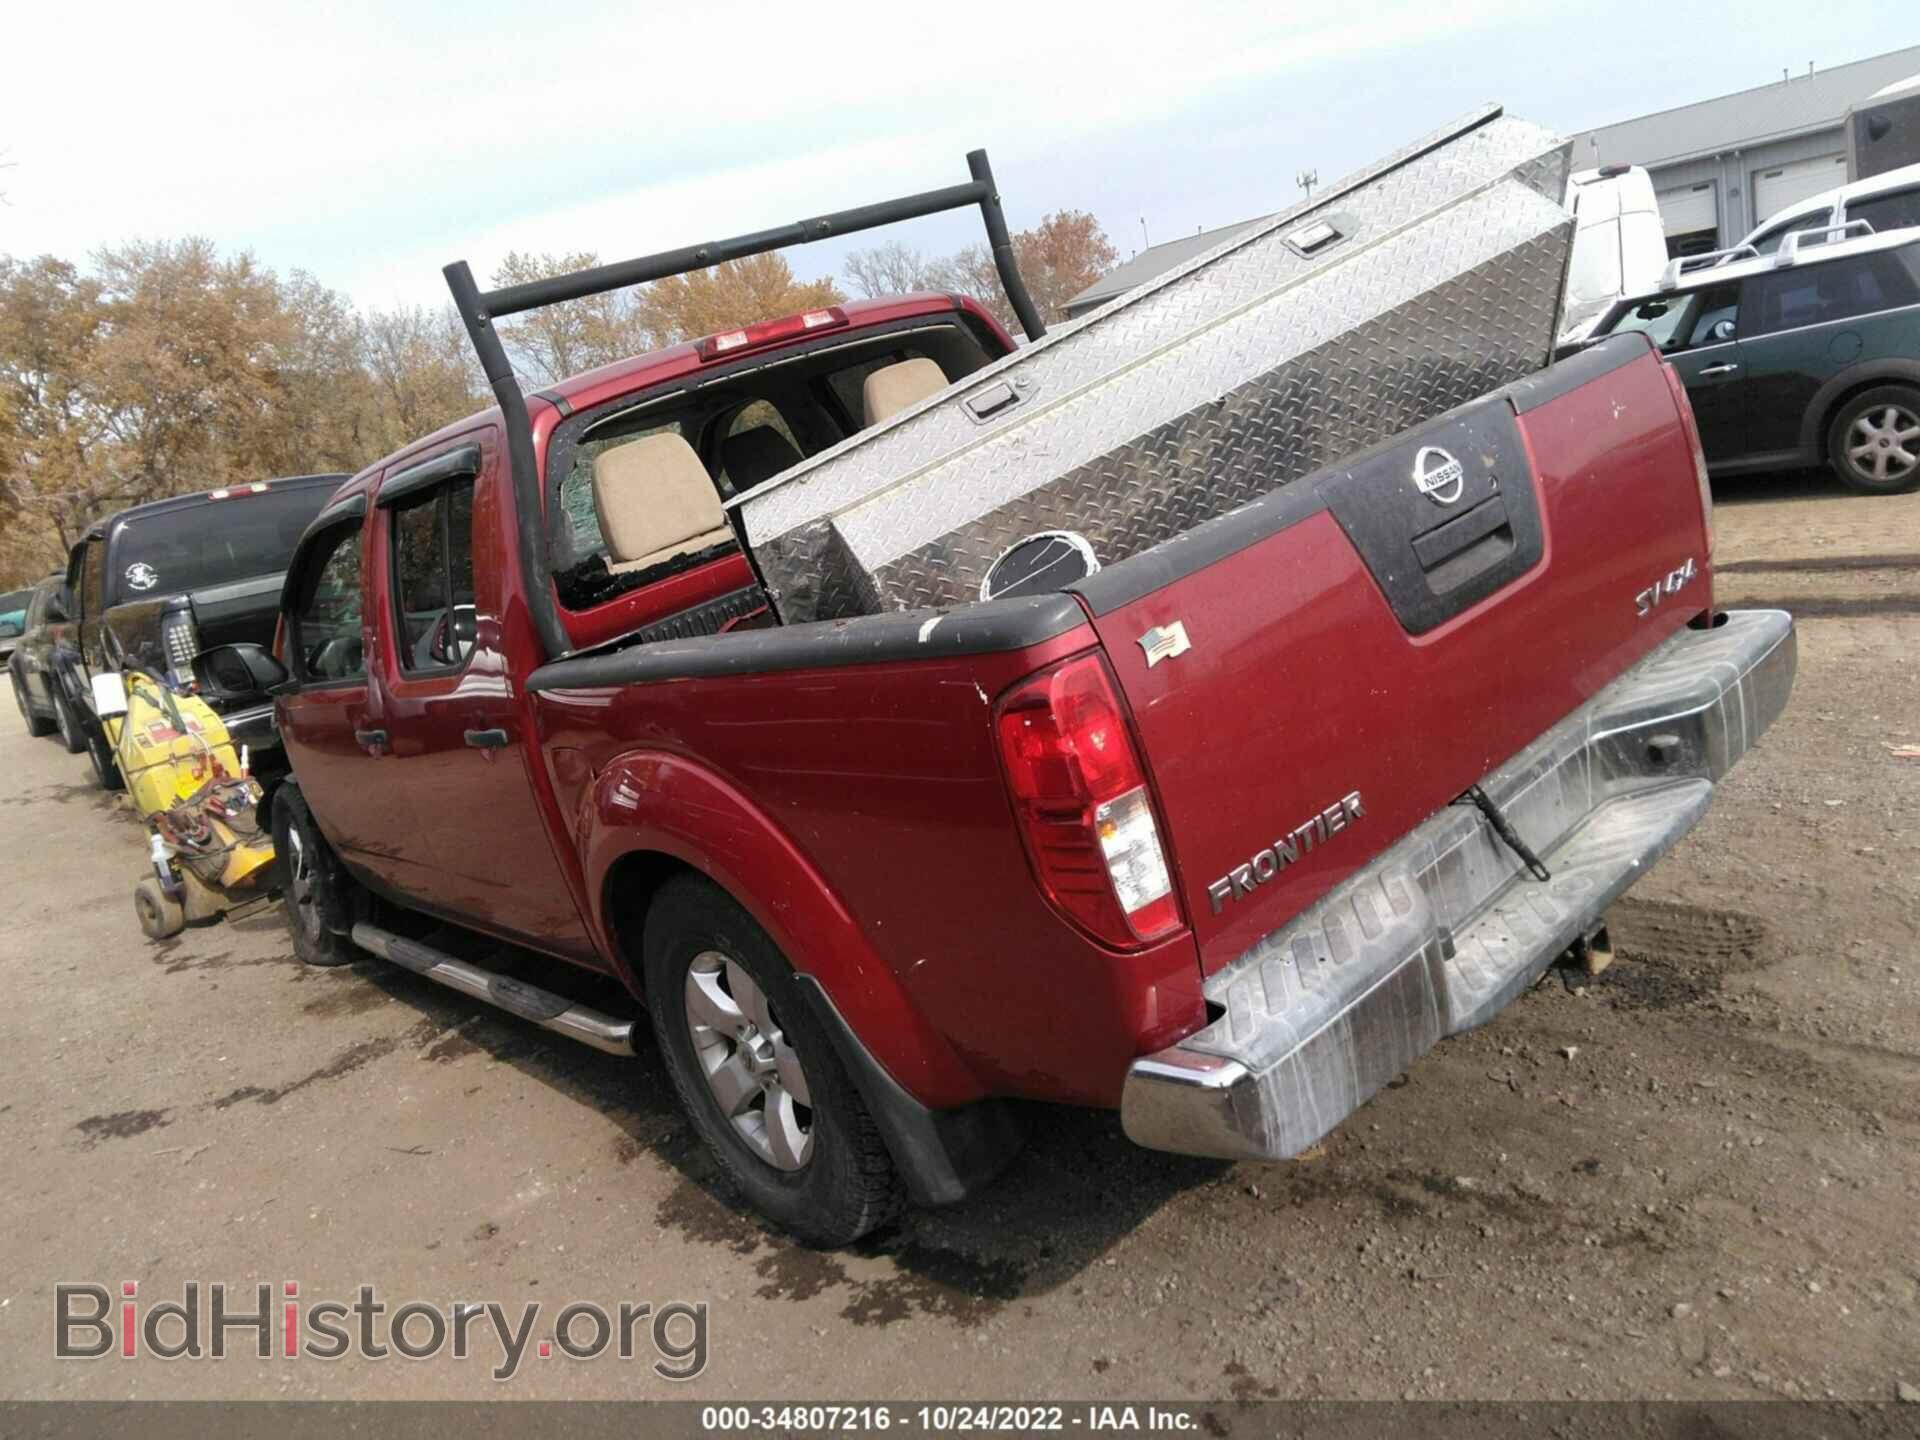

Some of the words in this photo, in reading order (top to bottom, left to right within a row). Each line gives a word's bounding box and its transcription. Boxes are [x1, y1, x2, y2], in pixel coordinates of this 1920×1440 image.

[1424, 463, 1461, 488] NISSAN
[1635, 581, 1661, 616] SV
[1207, 790, 1367, 914] FRONTIER
